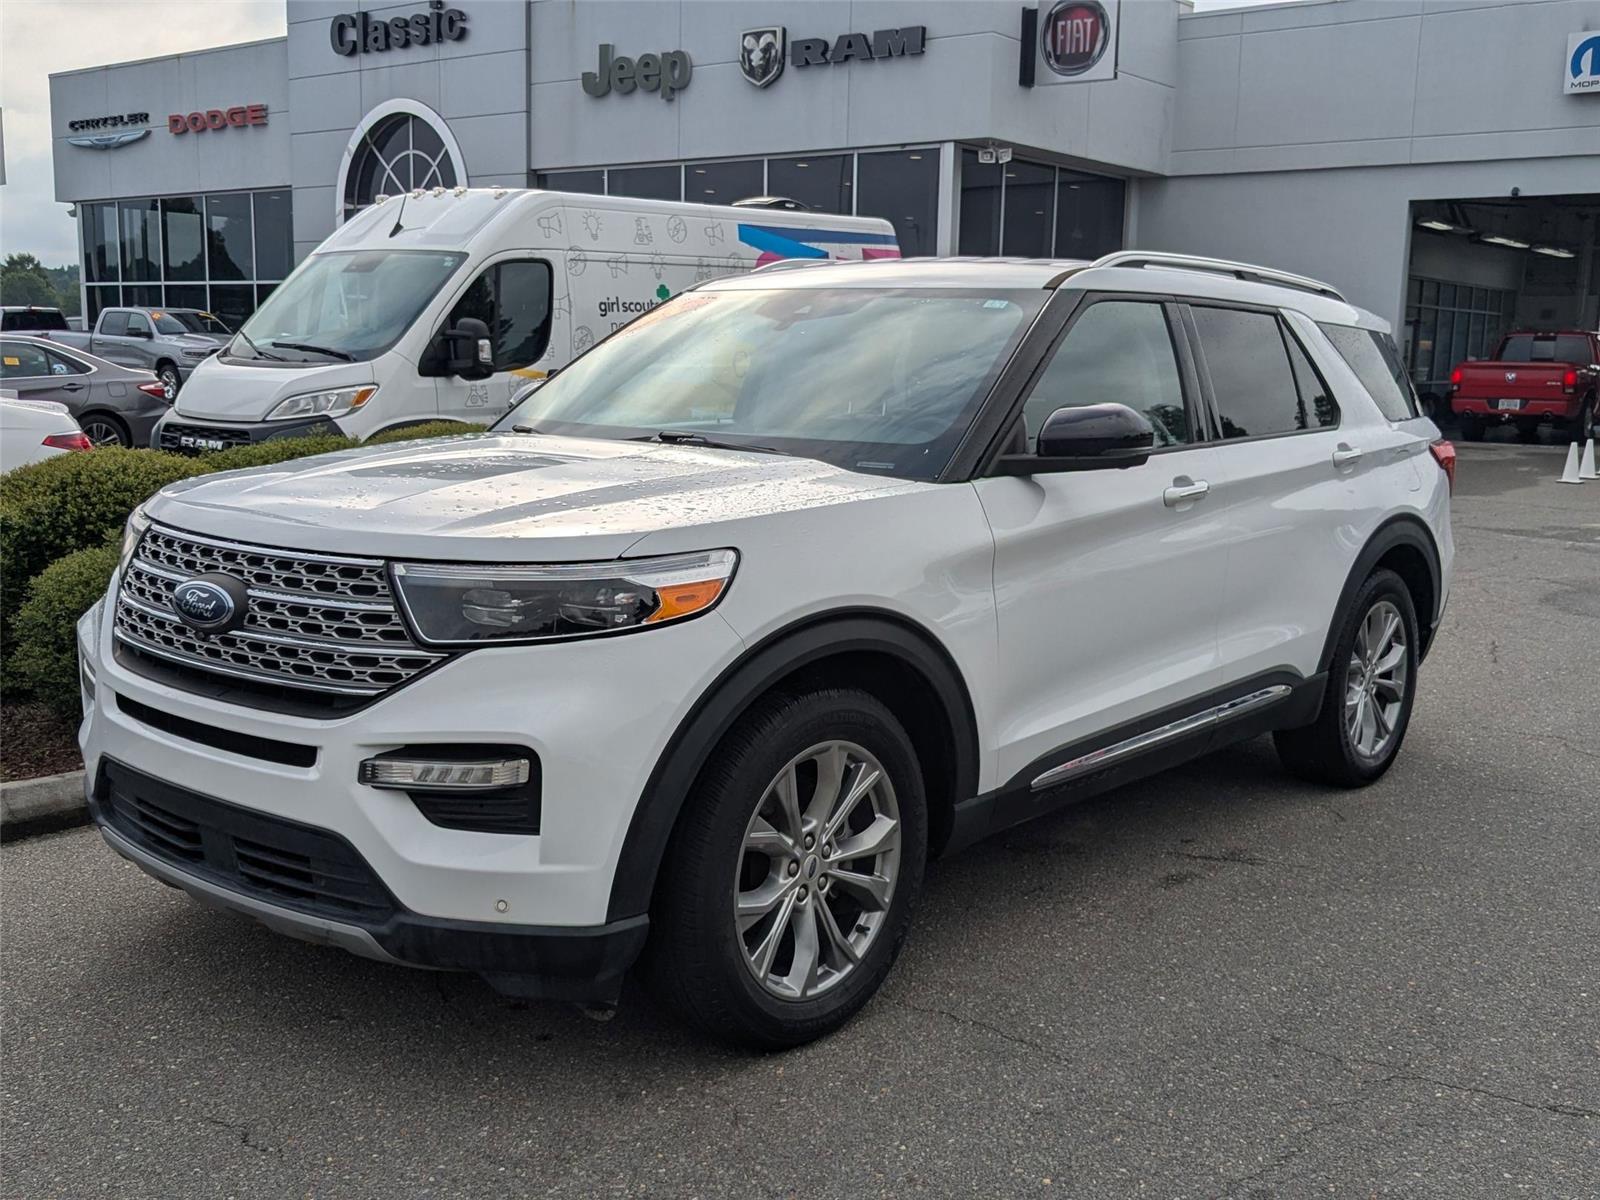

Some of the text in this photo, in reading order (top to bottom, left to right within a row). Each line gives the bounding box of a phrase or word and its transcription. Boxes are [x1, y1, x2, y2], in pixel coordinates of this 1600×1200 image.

[330, 0, 467, 56] Classic
[1056, 17, 1095, 56] FIAT
[791, 25, 926, 67] RAM
[581, 43, 693, 102] Jeep
[1570, 80, 1600, 89] MOP
[69, 112, 149, 132] CHRYSLER
[168, 104, 268, 135] DODGE
[598, 296, 620, 317] girl
[180, 436, 224, 451] RAM
[182, 589, 216, 617] Ford
